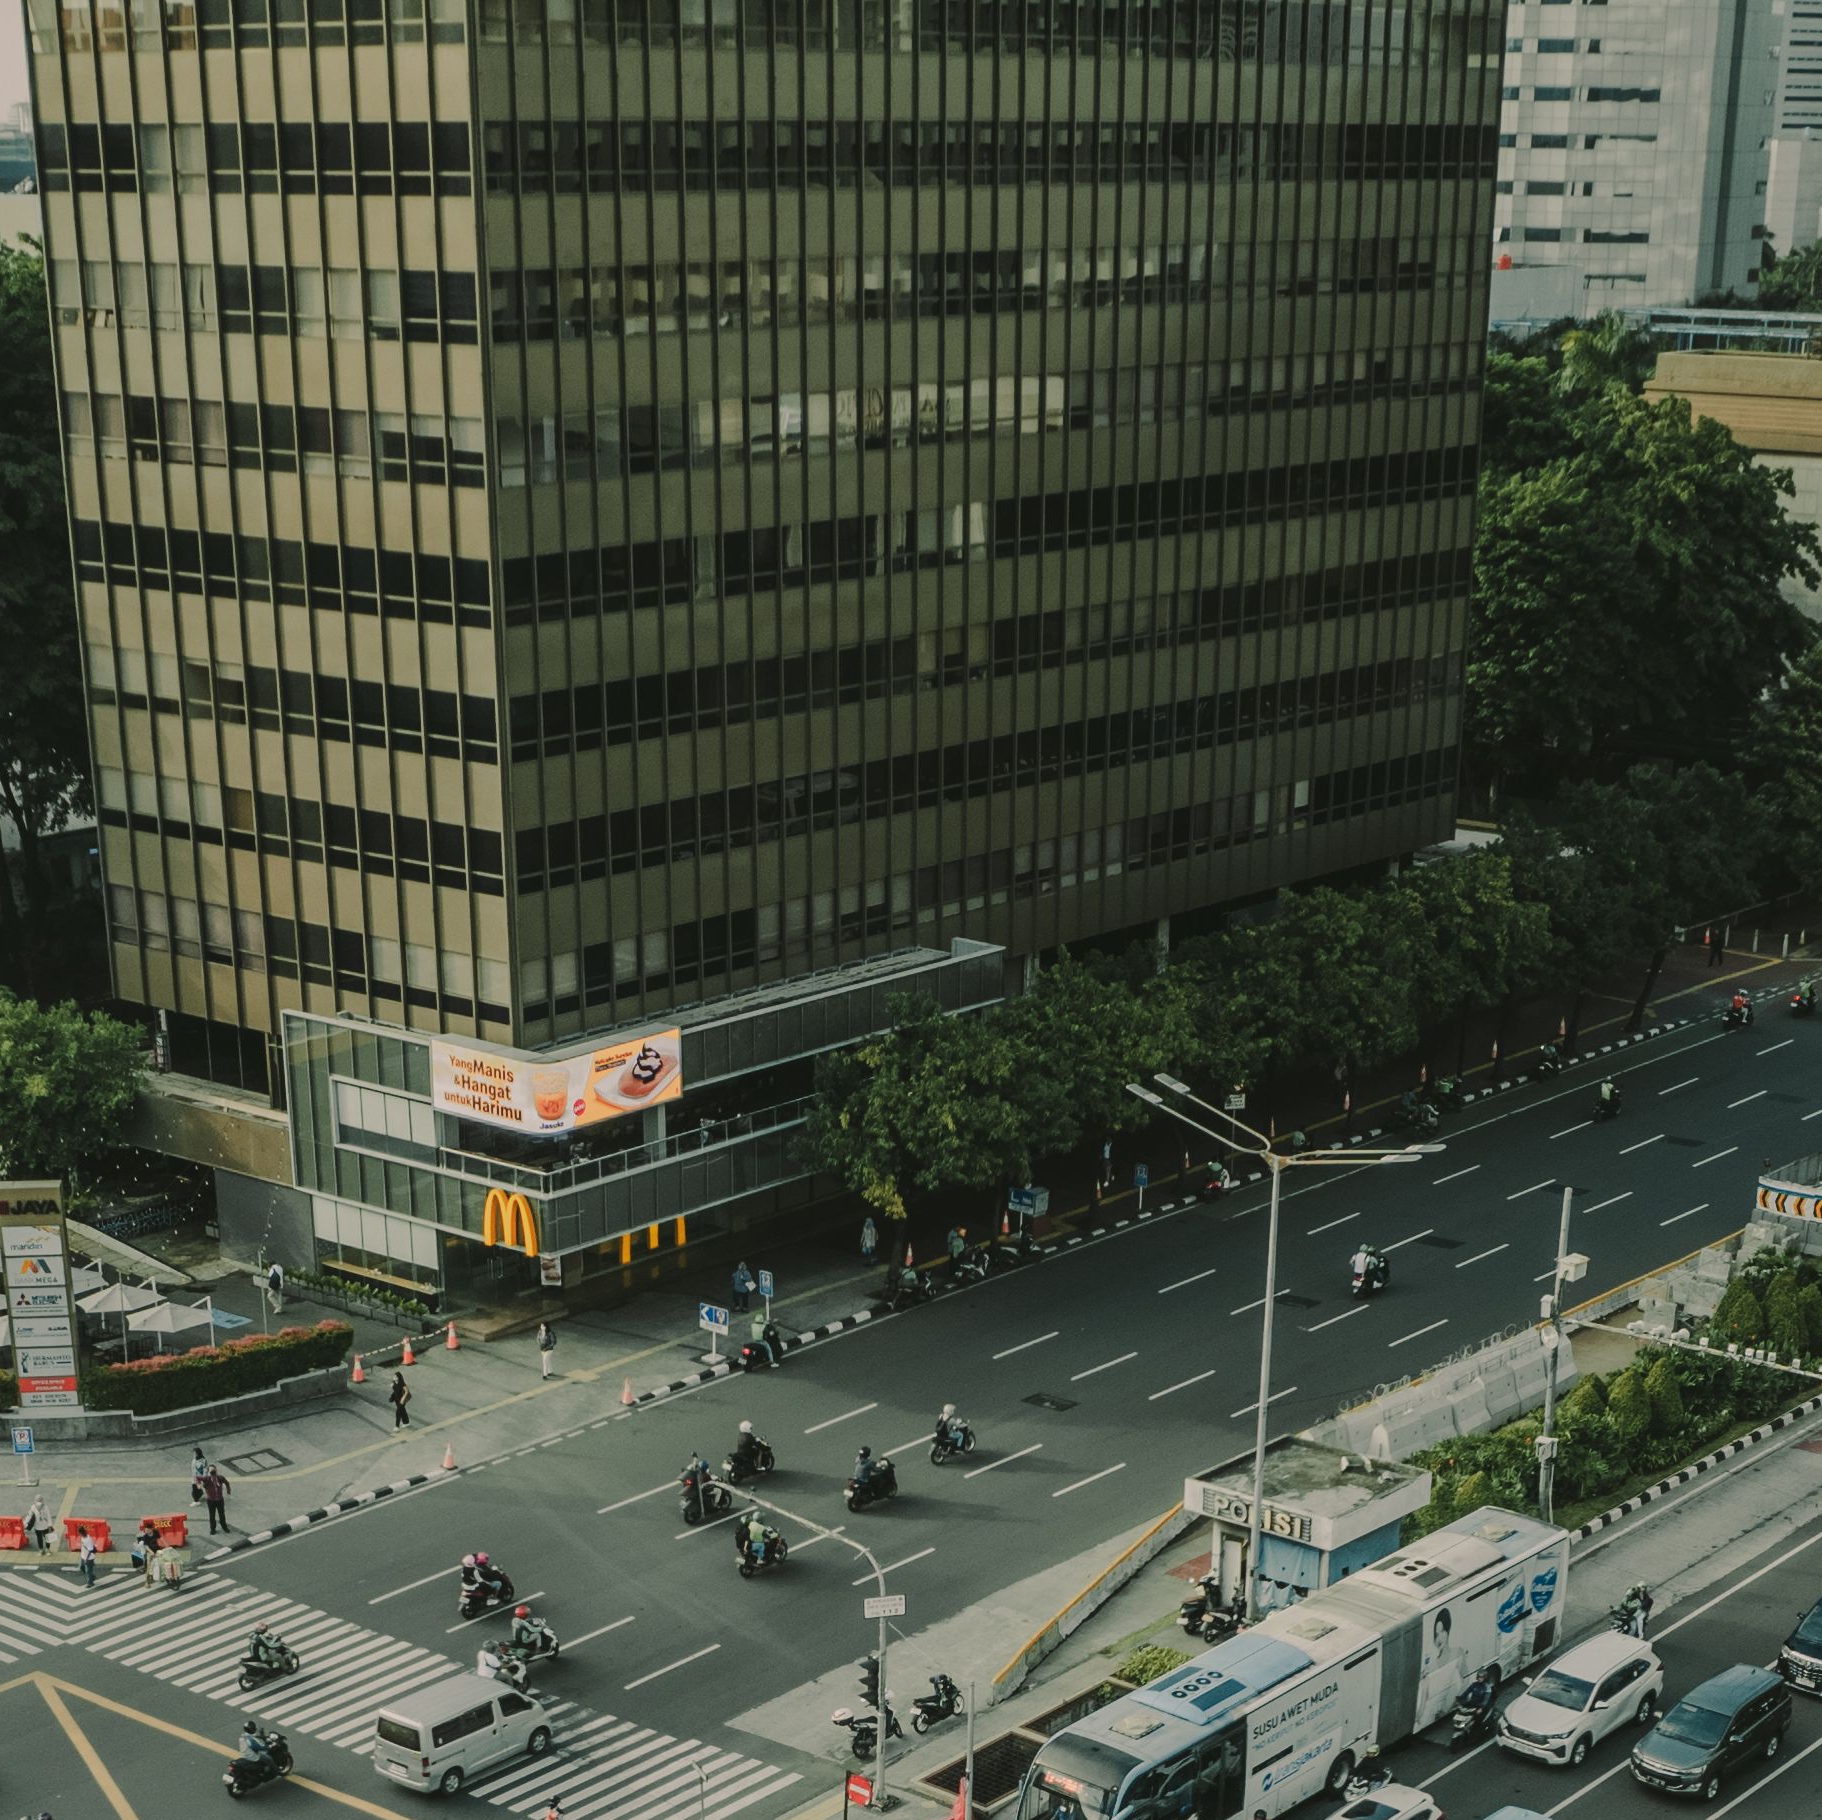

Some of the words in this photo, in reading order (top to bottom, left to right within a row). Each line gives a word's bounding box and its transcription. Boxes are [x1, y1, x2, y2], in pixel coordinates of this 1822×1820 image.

[449, 1055, 473, 1073] Yang
[473, 1058, 515, 1083] Manis
[461, 1077, 512, 1101] Hangat
[444, 1091, 472, 1107] untuk
[472, 1095, 523, 1122] Harimu
[10, 1199, 60, 1215] JAYA
[35, 1276, 59, 1284] MEGA
[1253, 1717, 1279, 1740] SUSU
[1280, 1698, 1309, 1724] AWET
[1310, 1682, 1339, 1707] MUDA
